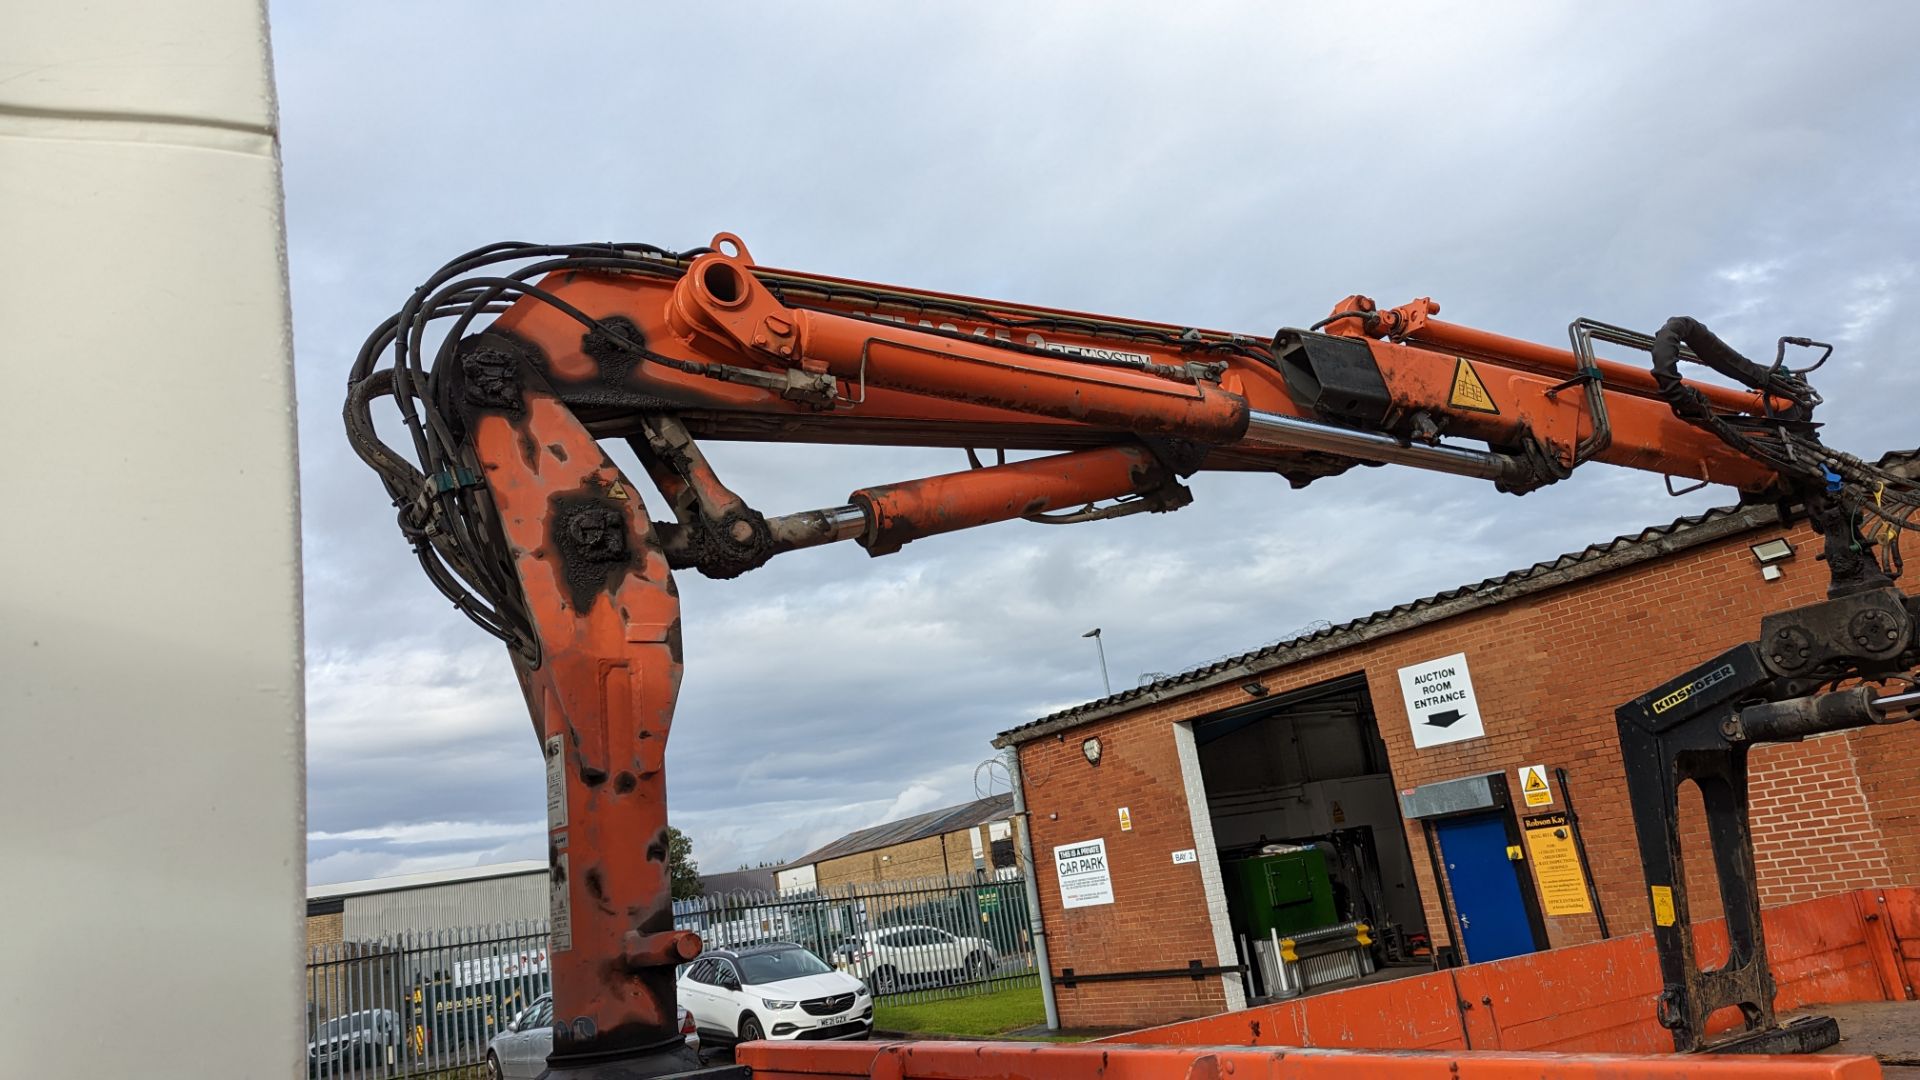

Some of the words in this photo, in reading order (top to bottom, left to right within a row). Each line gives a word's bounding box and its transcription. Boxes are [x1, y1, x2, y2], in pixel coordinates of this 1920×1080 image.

[1414, 667, 1456, 685] AUCTION
[1422, 681, 1452, 695] ROOM
[1654, 666, 1732, 711] KINSHOFER
[1414, 690, 1466, 709] ENTRANCE
[1525, 817, 1552, 828] Robson
[1552, 816, 1565, 825] Kay
[1060, 850, 1070, 859] THIS
[1076, 849, 1081, 857] A
[1081, 845, 1100, 856] PRIVATE
[1175, 853, 1187, 862] BAY
[1059, 861, 1079, 875] CAR
[1079, 856, 1105, 872] PARK
